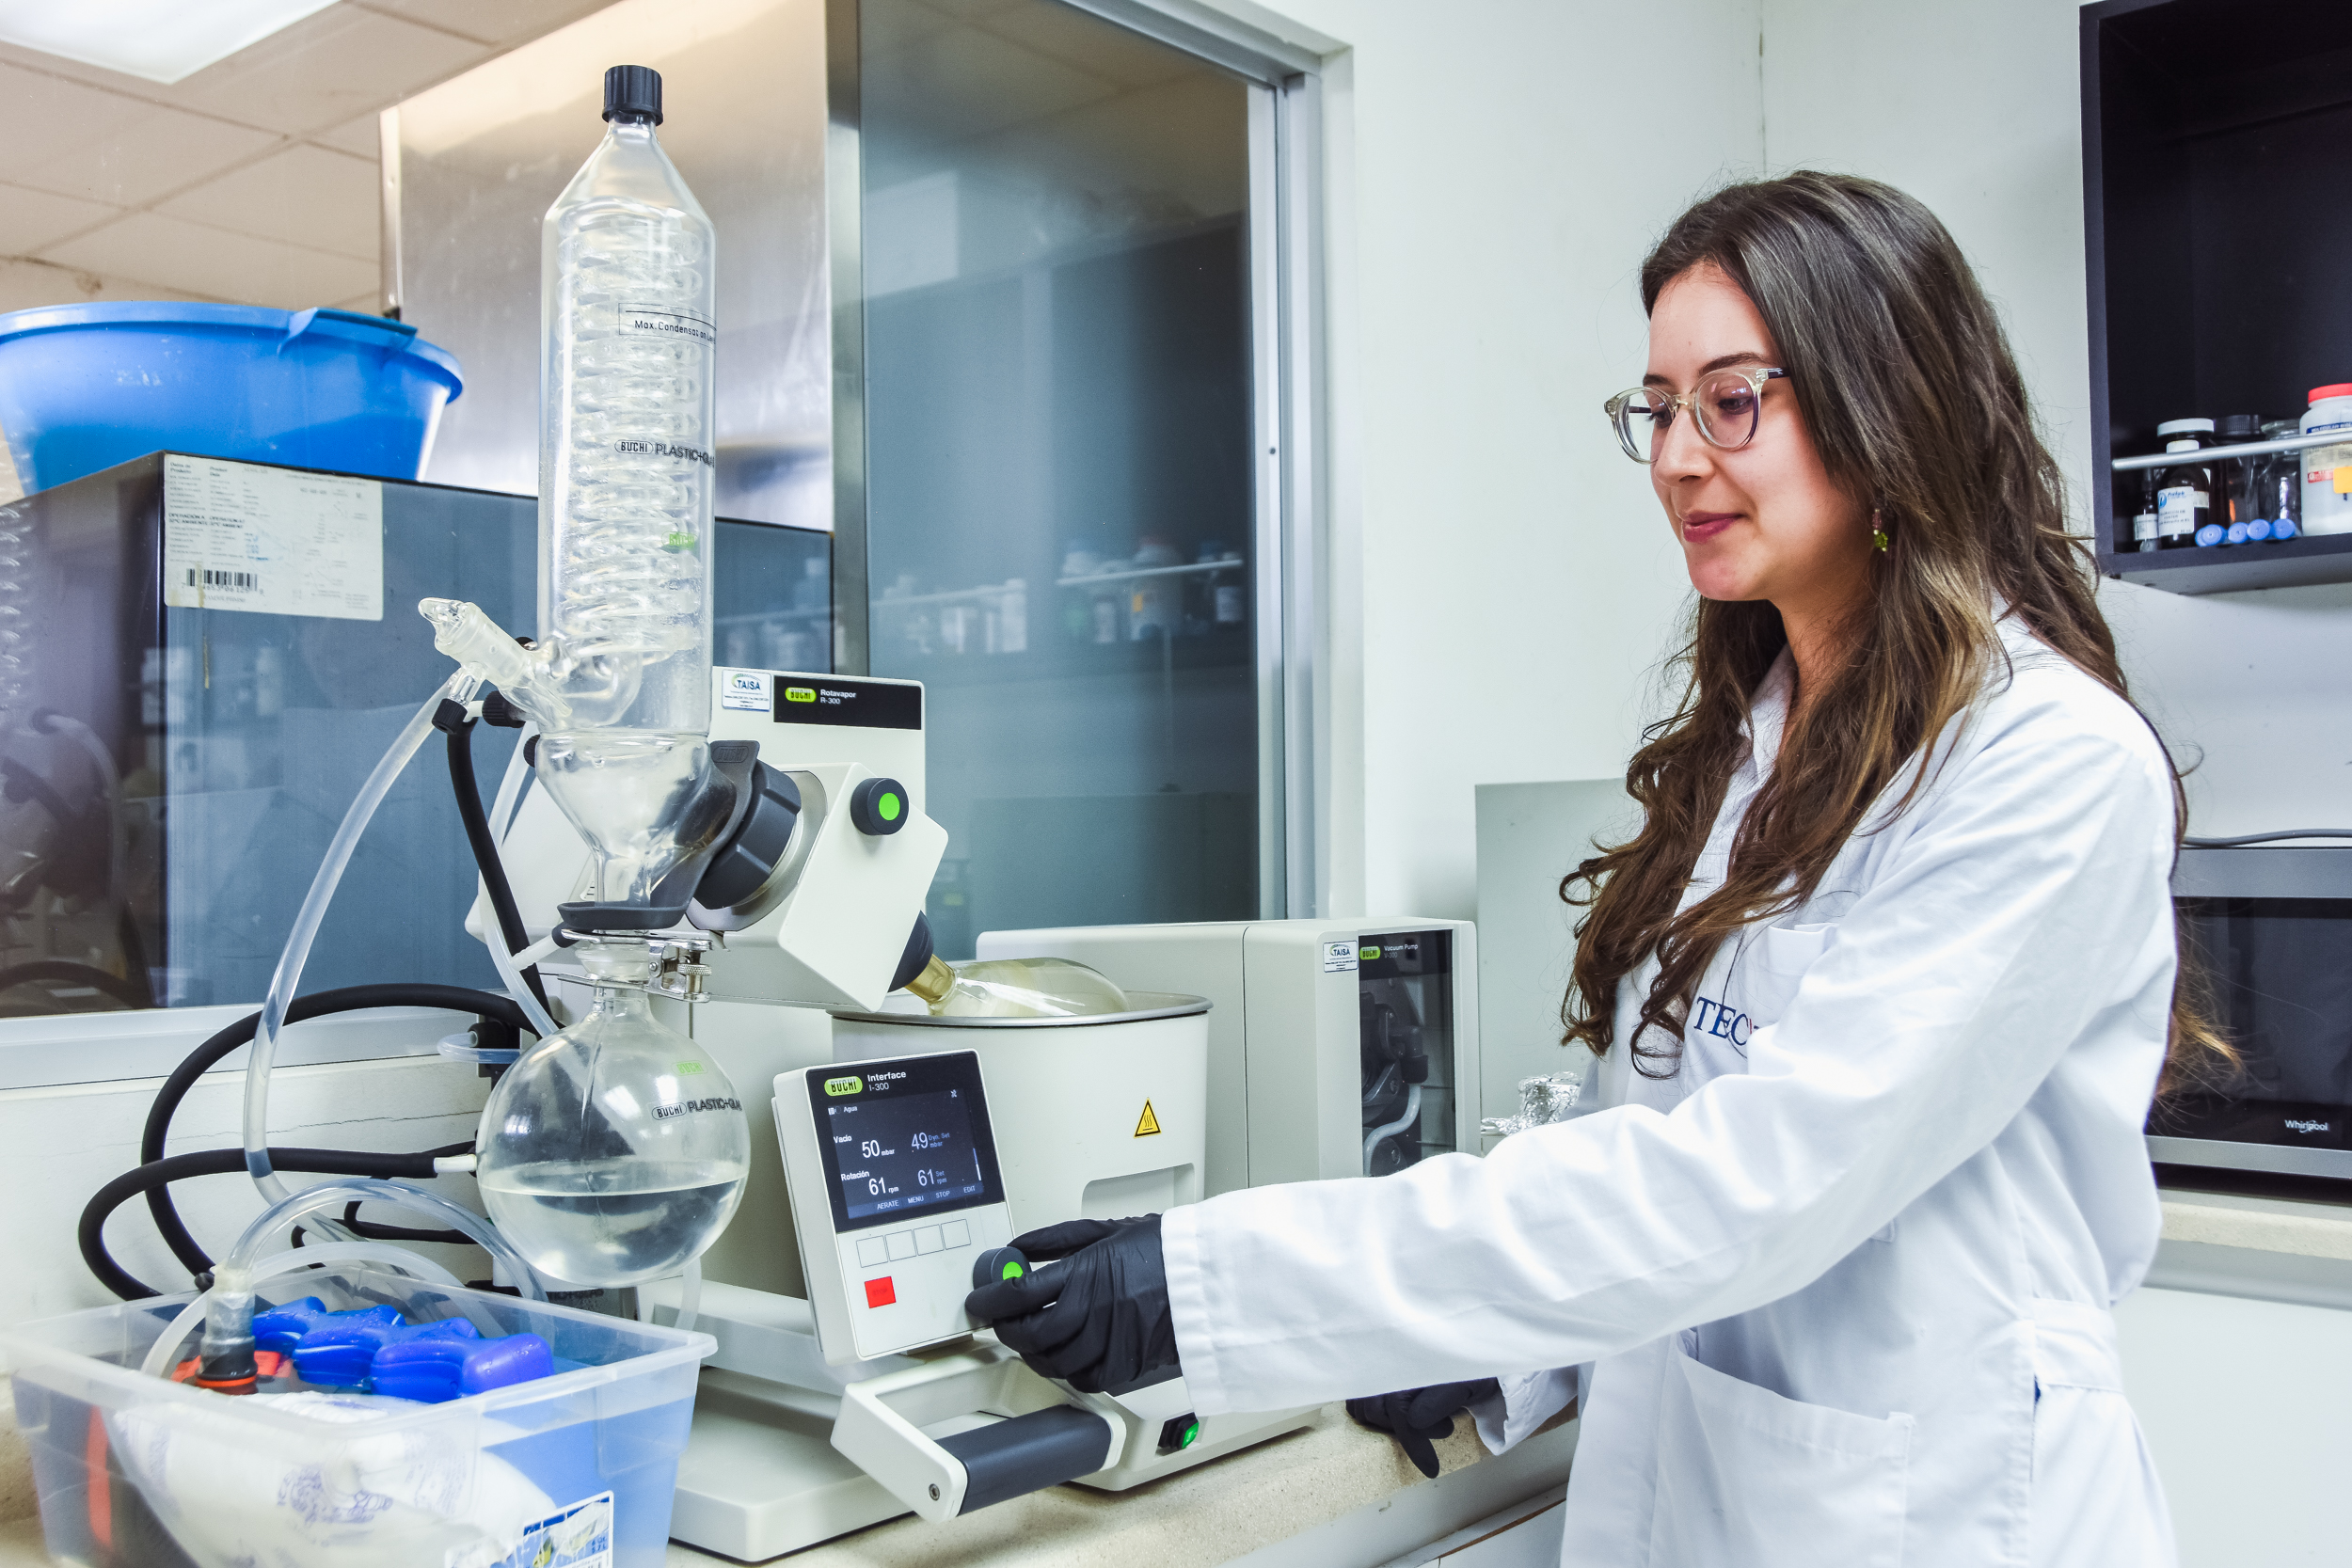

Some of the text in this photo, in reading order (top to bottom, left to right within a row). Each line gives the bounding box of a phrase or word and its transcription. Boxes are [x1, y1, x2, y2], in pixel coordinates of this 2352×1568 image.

[634, 320, 658, 330] Max.
[737, 679, 761, 690] TAISA
[819, 689, 857, 699] Rotavapor
[819, 696, 841, 705] R-300
[1404, 940, 1419, 950] Pump
[867, 1071, 907, 1083] Interface
[868, 1082, 890, 1092] I-300
[657, 1104, 683, 1118] BUCHI
[2284, 1118, 2328, 1133] Whirlpool
[911, 1132, 929, 1150] 49
[861, 1139, 881, 1158] 50
[840, 1170, 870, 1181] Rotación
[917, 1168, 935, 1187] 61
[868, 1176, 886, 1196] 61
[877, 1185, 977, 1211] AERATE MENU STOP EDIT
